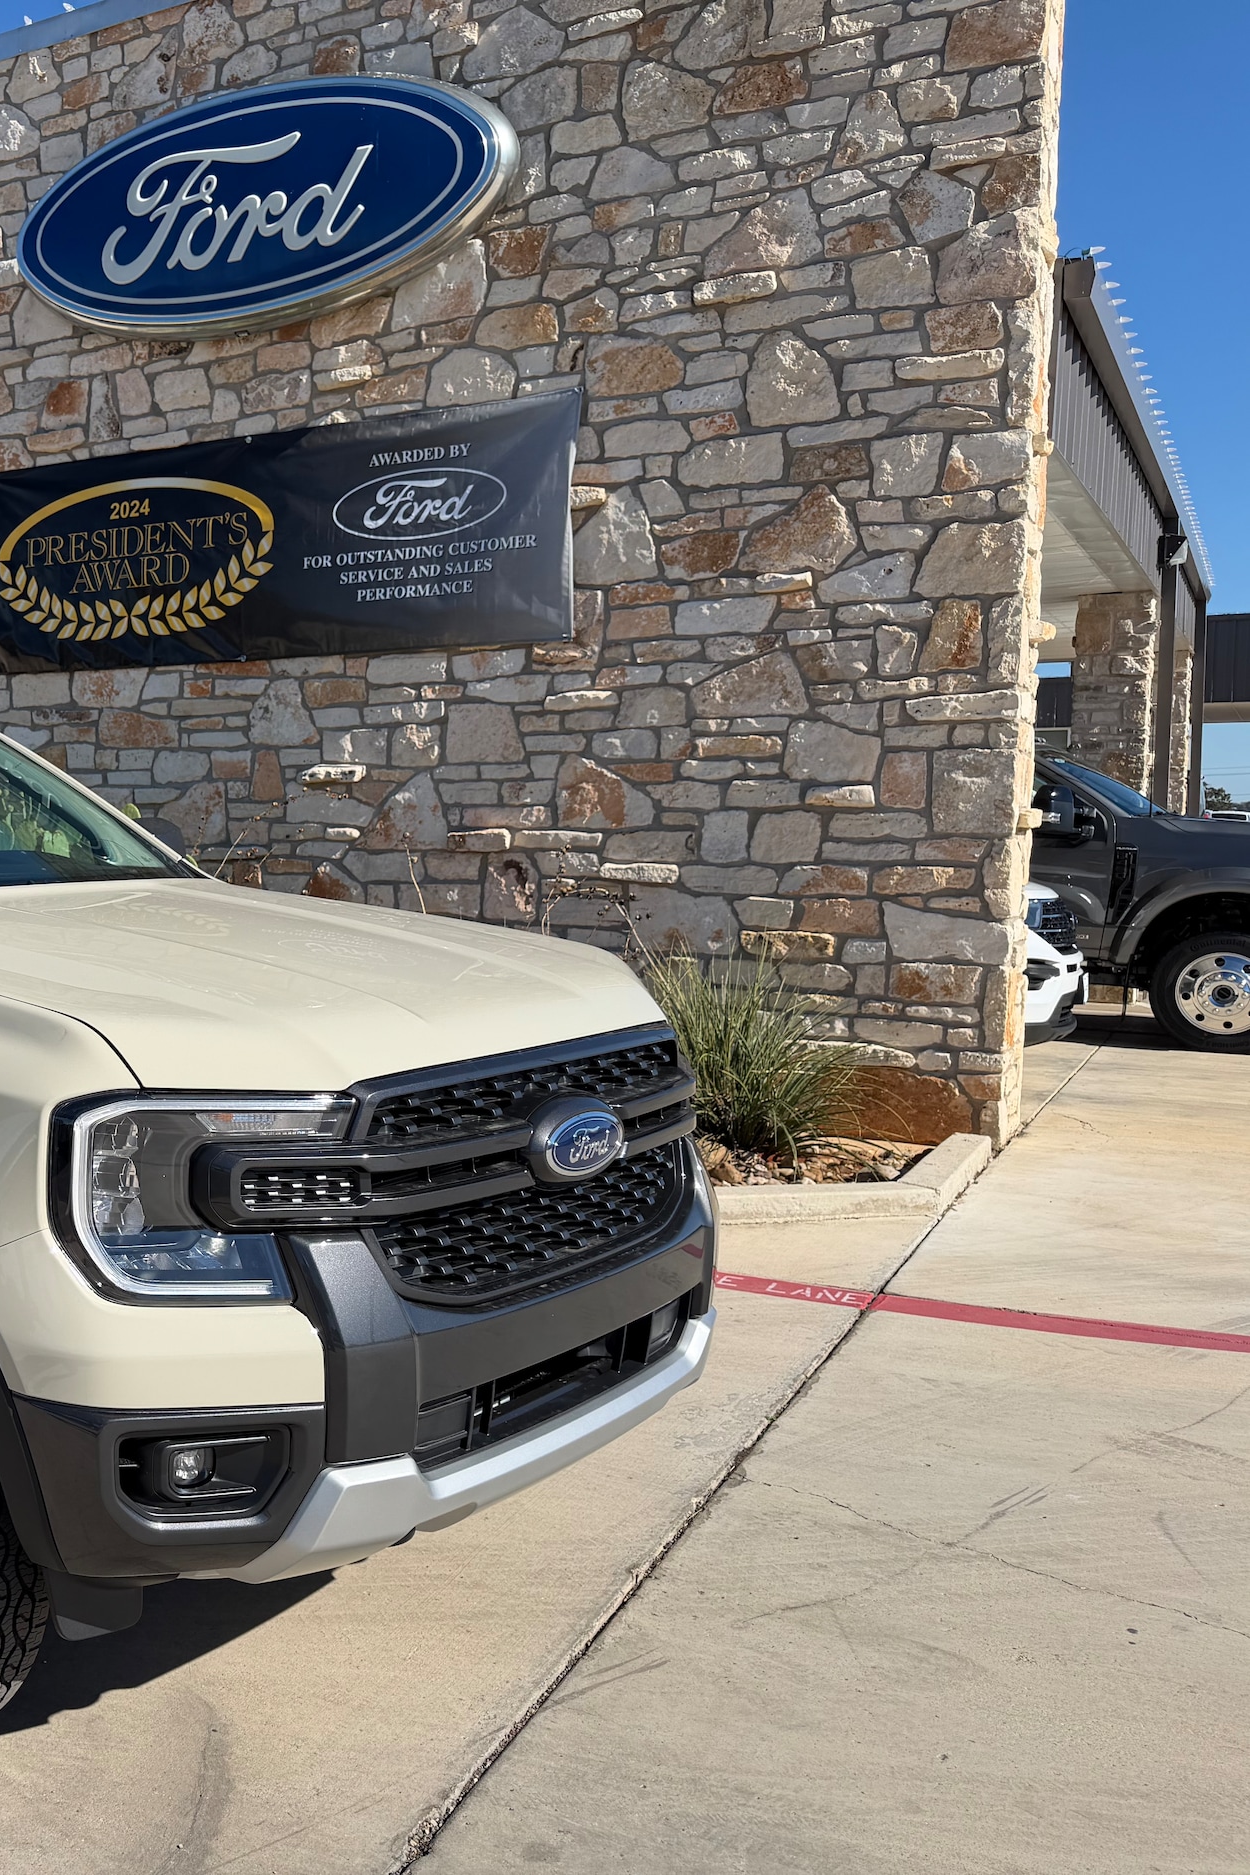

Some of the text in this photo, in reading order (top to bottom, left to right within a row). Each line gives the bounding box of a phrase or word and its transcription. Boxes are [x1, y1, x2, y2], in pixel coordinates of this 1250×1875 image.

[102, 131, 374, 286] Ford
[369, 443, 471, 468] AWARDED BY
[109, 498, 150, 520] 2024
[363, 477, 475, 530] Ford
[25, 511, 248, 568] PRESIDENT'S
[303, 534, 538, 570] FOR OUTSTANDING CUSTOMER
[69, 553, 190, 594] AWARD
[339, 558, 493, 585] SERVICE AND SALES
[356, 580, 474, 602] PERFORMANCE
[569, 1126, 610, 1163] Ford
[765, 1282, 866, 1304] LANE
